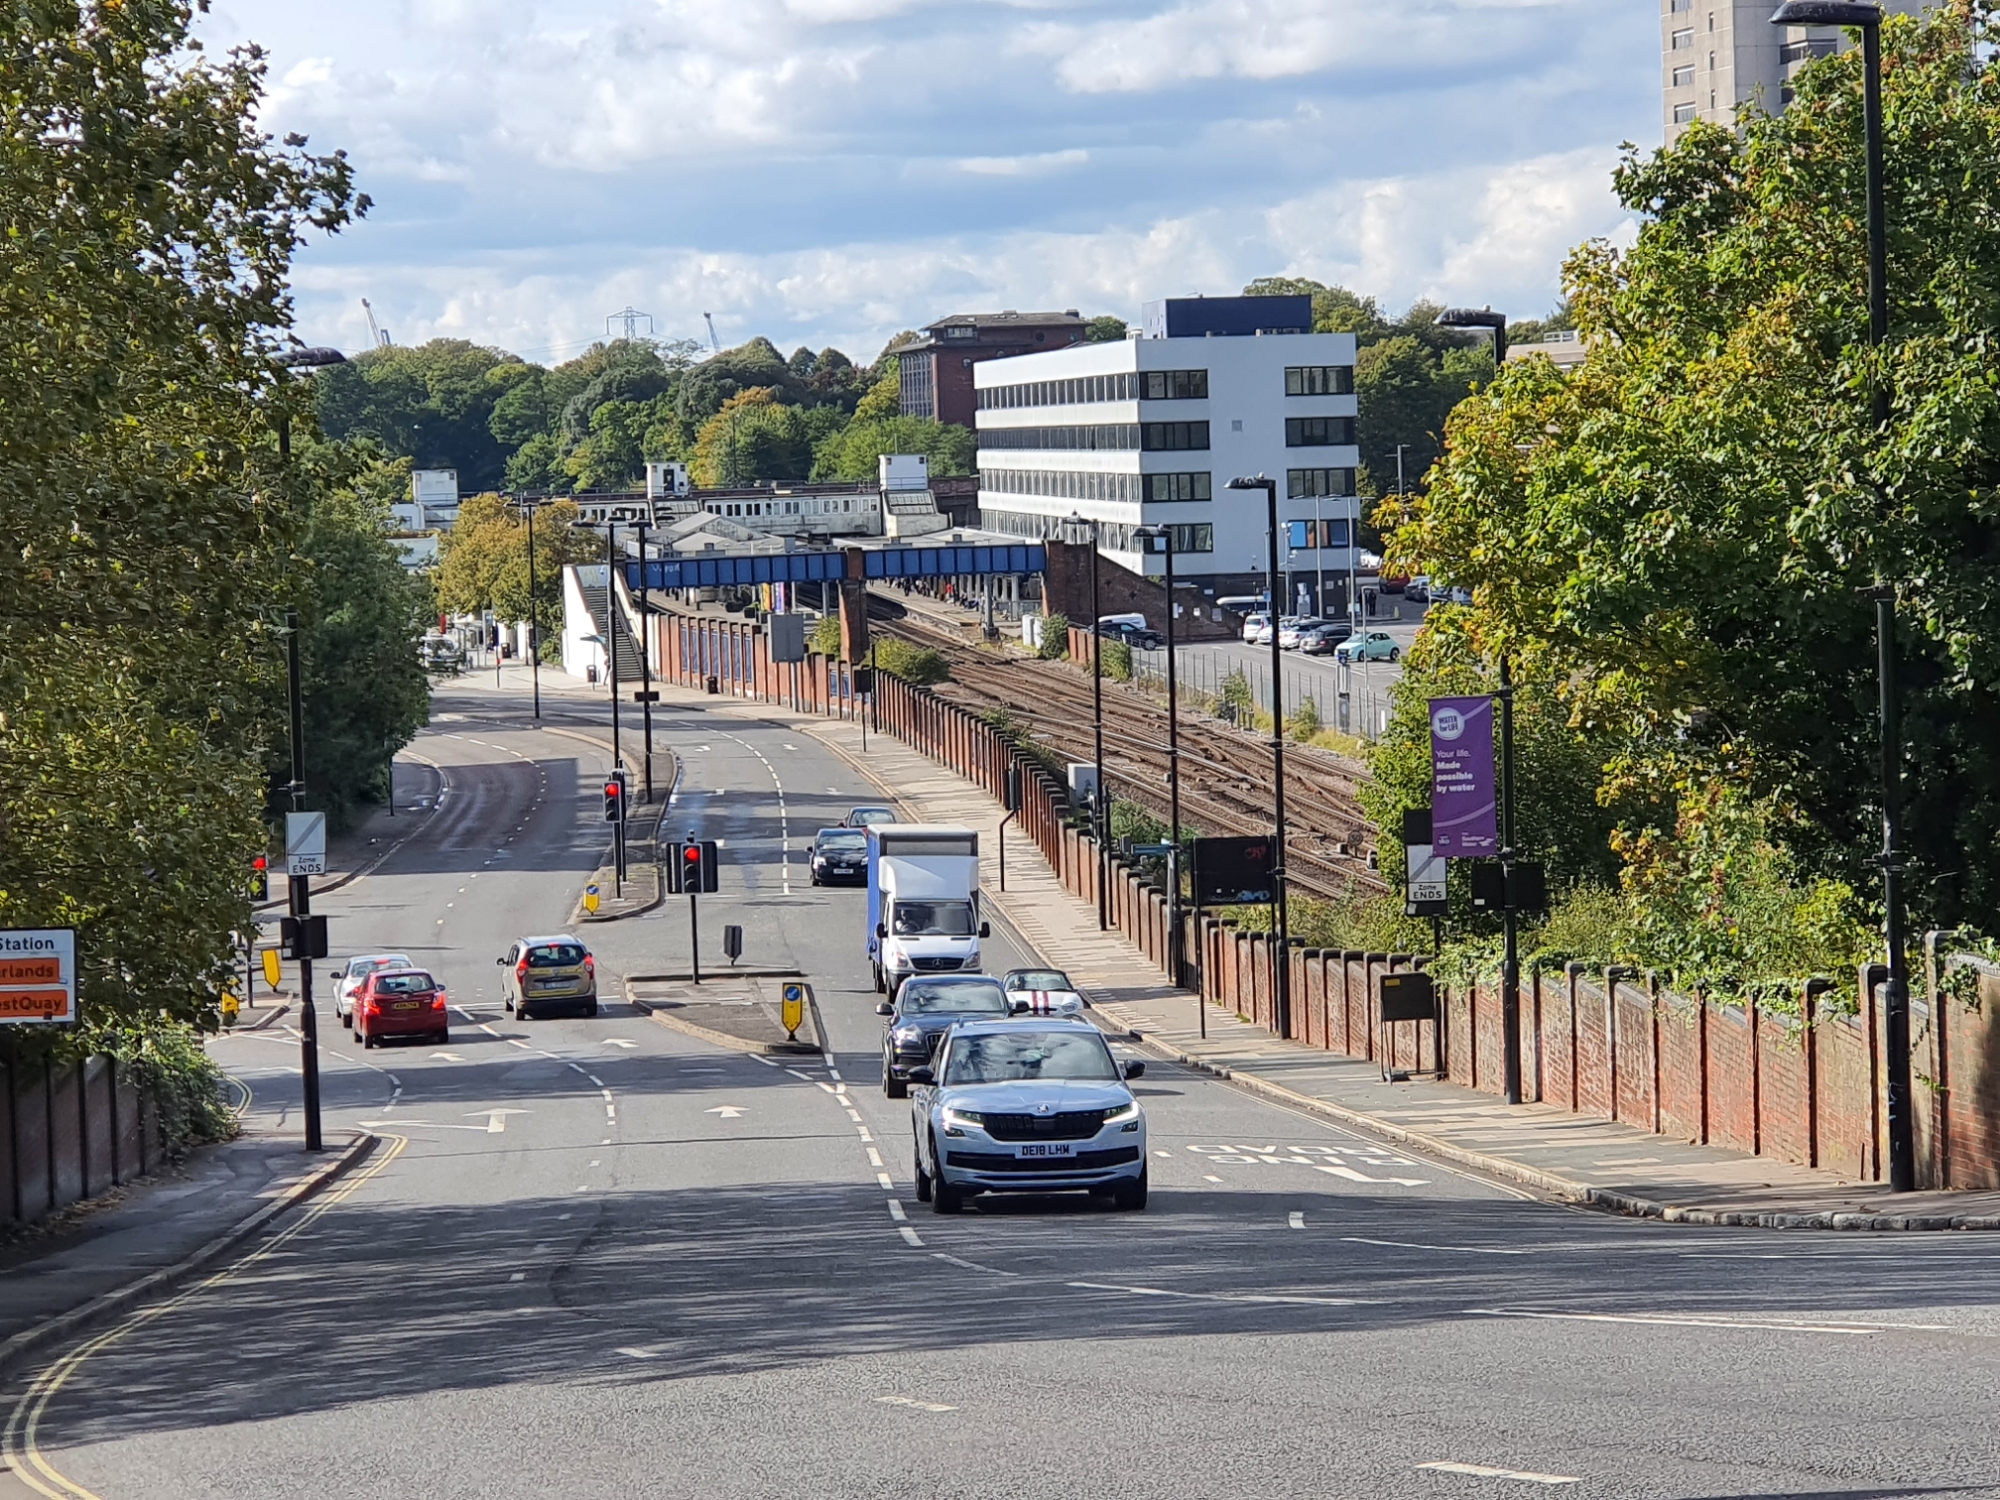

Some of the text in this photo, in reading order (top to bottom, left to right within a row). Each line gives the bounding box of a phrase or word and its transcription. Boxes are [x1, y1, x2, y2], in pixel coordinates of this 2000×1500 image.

[1435, 749, 1455, 758] Your
[1436, 761, 1461, 770] Made
[1436, 772, 1474, 783] possible
[1436, 783, 1476, 794] by water
[292, 864, 322, 874] ENDS
[1413, 891, 1442, 899] ENDS
[0, 964, 54, 979] rlands
[1022, 1145, 1046, 1156] DE18
[1186, 1145, 1392, 1155] ROAD
[1207, 1155, 1420, 1165] RING
